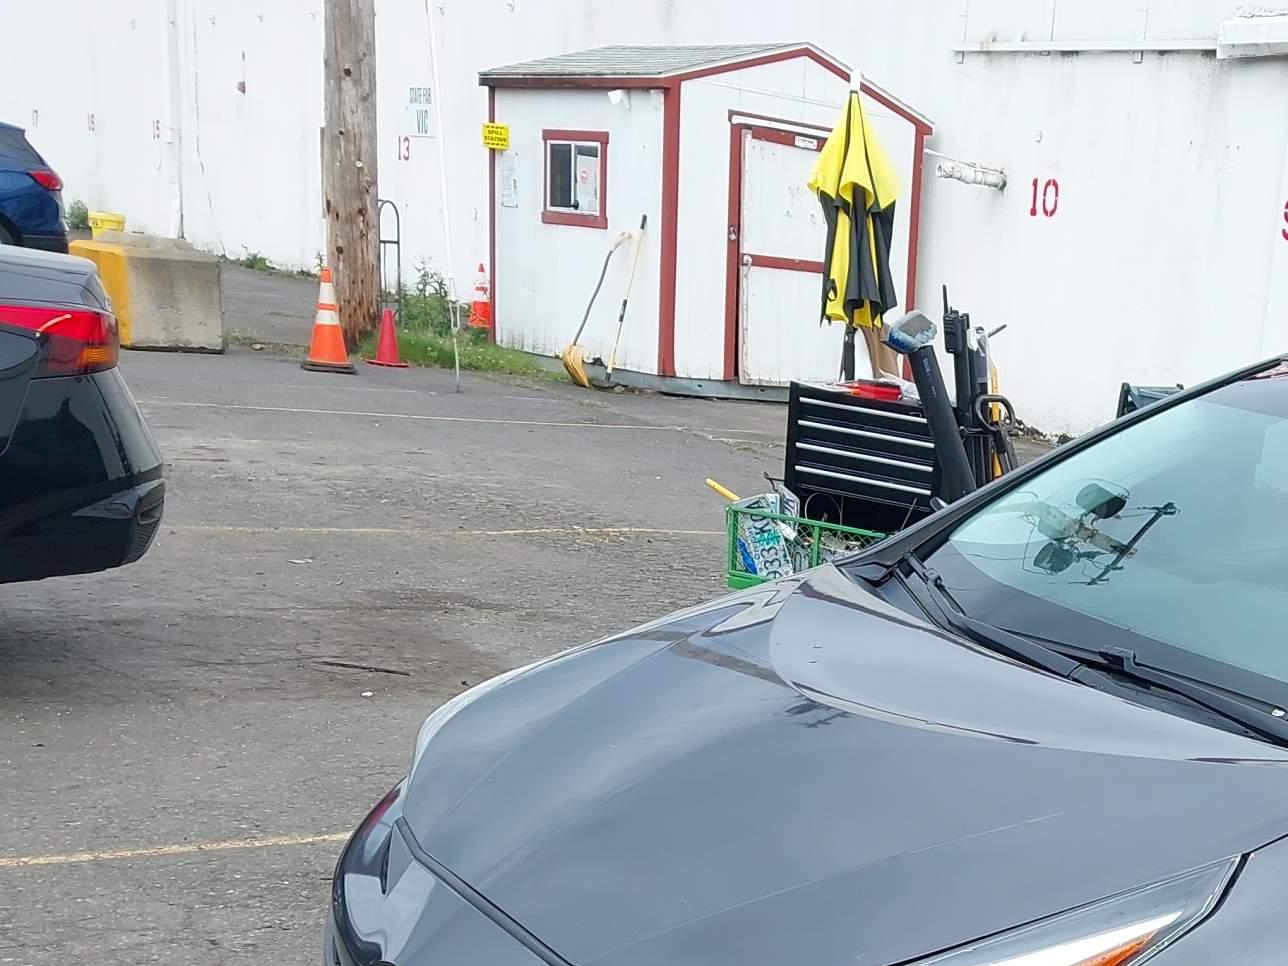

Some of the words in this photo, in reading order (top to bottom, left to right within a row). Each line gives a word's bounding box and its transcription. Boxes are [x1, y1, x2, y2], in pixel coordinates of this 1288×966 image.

[416, 109, 429, 135] VIC
[487, 129, 504, 137] SPILL
[398, 135, 411, 161] 13
[484, 135, 507, 143] STATION
[1029, 177, 1059, 218] 10
